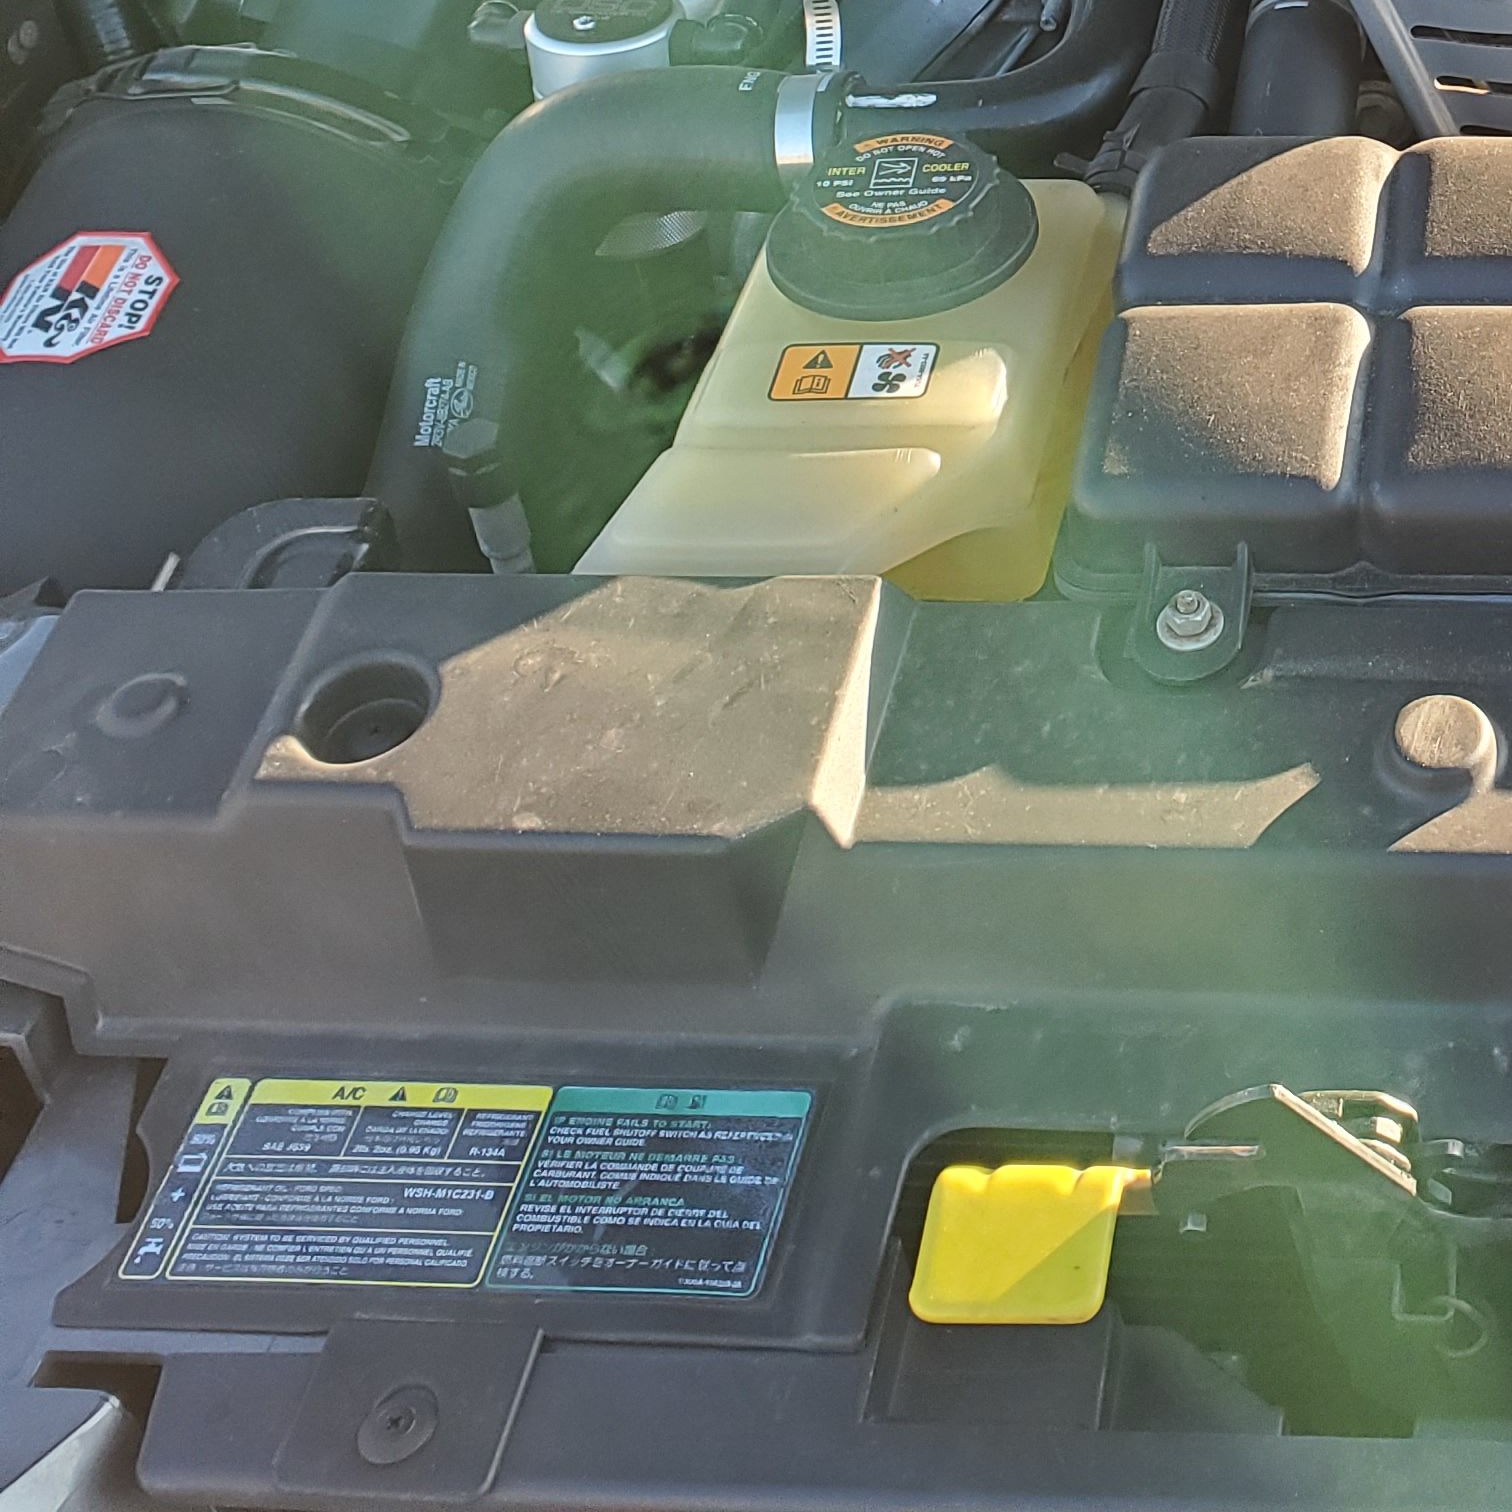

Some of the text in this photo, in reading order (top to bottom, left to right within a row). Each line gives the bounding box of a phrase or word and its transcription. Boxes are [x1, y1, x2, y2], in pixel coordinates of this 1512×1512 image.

[876, 136, 944, 147] WARNING
[855, 145, 947, 162] DO NOT OPEN HOT
[827, 166, 866, 176] INTER
[922, 162, 970, 173] COOLER
[832, 179, 854, 187] PSI
[836, 187, 947, 199] See Owner Guide
[848, 200, 929, 214] OUVRIR CHAUD
[871, 200, 907, 209] NE PAS
[836, 203, 943, 225] AVERTISSEMENT
[122, 248, 139, 263] This
[117, 265, 128, 273] is
[90, 254, 152, 345] DO NOT DISCARD
[93, 281, 114, 311] Lifetime
[117, 274, 164, 330] STOP!
[31, 279, 101, 348] K&N
[87, 313, 99, 324] Air
[413, 377, 442, 447] Motorcraft
[332, 1086, 367, 1100] A/C
[568, 1117, 614, 1126] ENGINE
[616, 1118, 649, 1127] FAILS
[652, 1119, 668, 1128] TO
[549, 1126, 585, 1135] CHECK
[585, 1127, 610, 1136] FUEL
[612, 1128, 658, 1137] SHUTOFF
[659, 1129, 698, 1139] SWITCH
[547, 1135, 613, 1146] YOUR OWNER
[469, 1147, 506, 1158] R-134A
[556, 1150, 573, 1159] LE
[574, 1150, 626, 1161] MOTEUR
[628, 1152, 645, 1161] NE
[584, 1161, 598, 1169] LA
[599, 1162, 658, 1171] COMMANDE
[660, 1163, 676, 1172] DE
[599, 1171, 638, 1181] COMME
[524, 1193, 539, 1202] SI
[540, 1194, 552, 1202] EL
[558, 1195, 601, 1204] MOTOR
[604, 1195, 622, 1205] NO
[519, 1204, 729, 1219] REVISE EL INTERRUPTOR DE DEL
[516, 1213, 761, 1230] COMBUSTIBLE COMO SE INDICA EN LA DEL
[512, 1223, 584, 1234] PROPIETARIO.
[270, 1234, 281, 1242] TO
[281, 1234, 294, 1242] BE
[295, 1235, 338, 1243] SERVICED
[338, 1235, 352, 1244] BY
[351, 1236, 397, 1245] QUALIFIED
